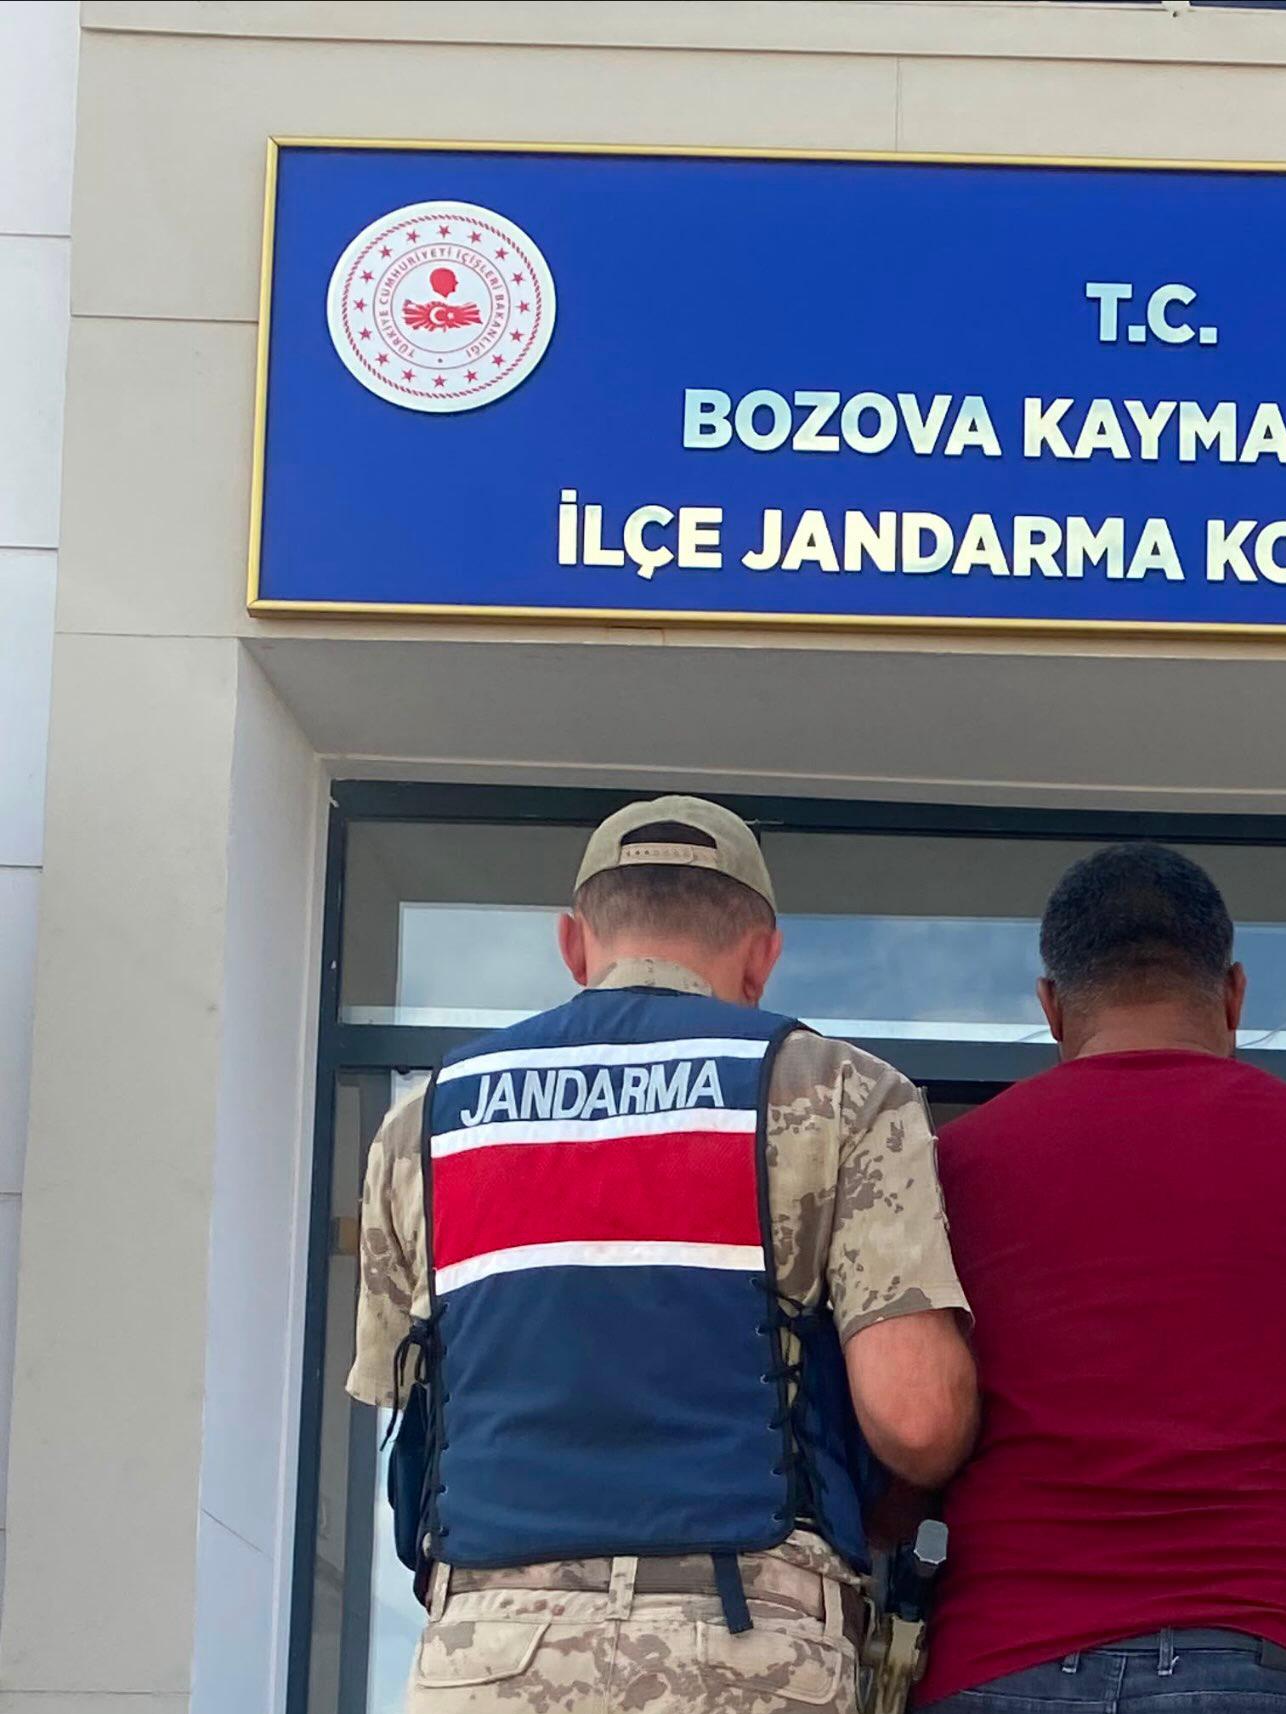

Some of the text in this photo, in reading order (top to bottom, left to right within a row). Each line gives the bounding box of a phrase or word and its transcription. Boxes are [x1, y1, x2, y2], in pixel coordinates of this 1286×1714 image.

[379, 246, 452, 305] CUMHURİYETİ
[1086, 282, 1218, 345] T.C.
[682, 387, 1002, 456] BOZOVA
[558, 488, 723, 580] İLÇE
[741, 507, 1185, 581] JANDARMA
[460, 1059, 725, 1127] JANDARMA
